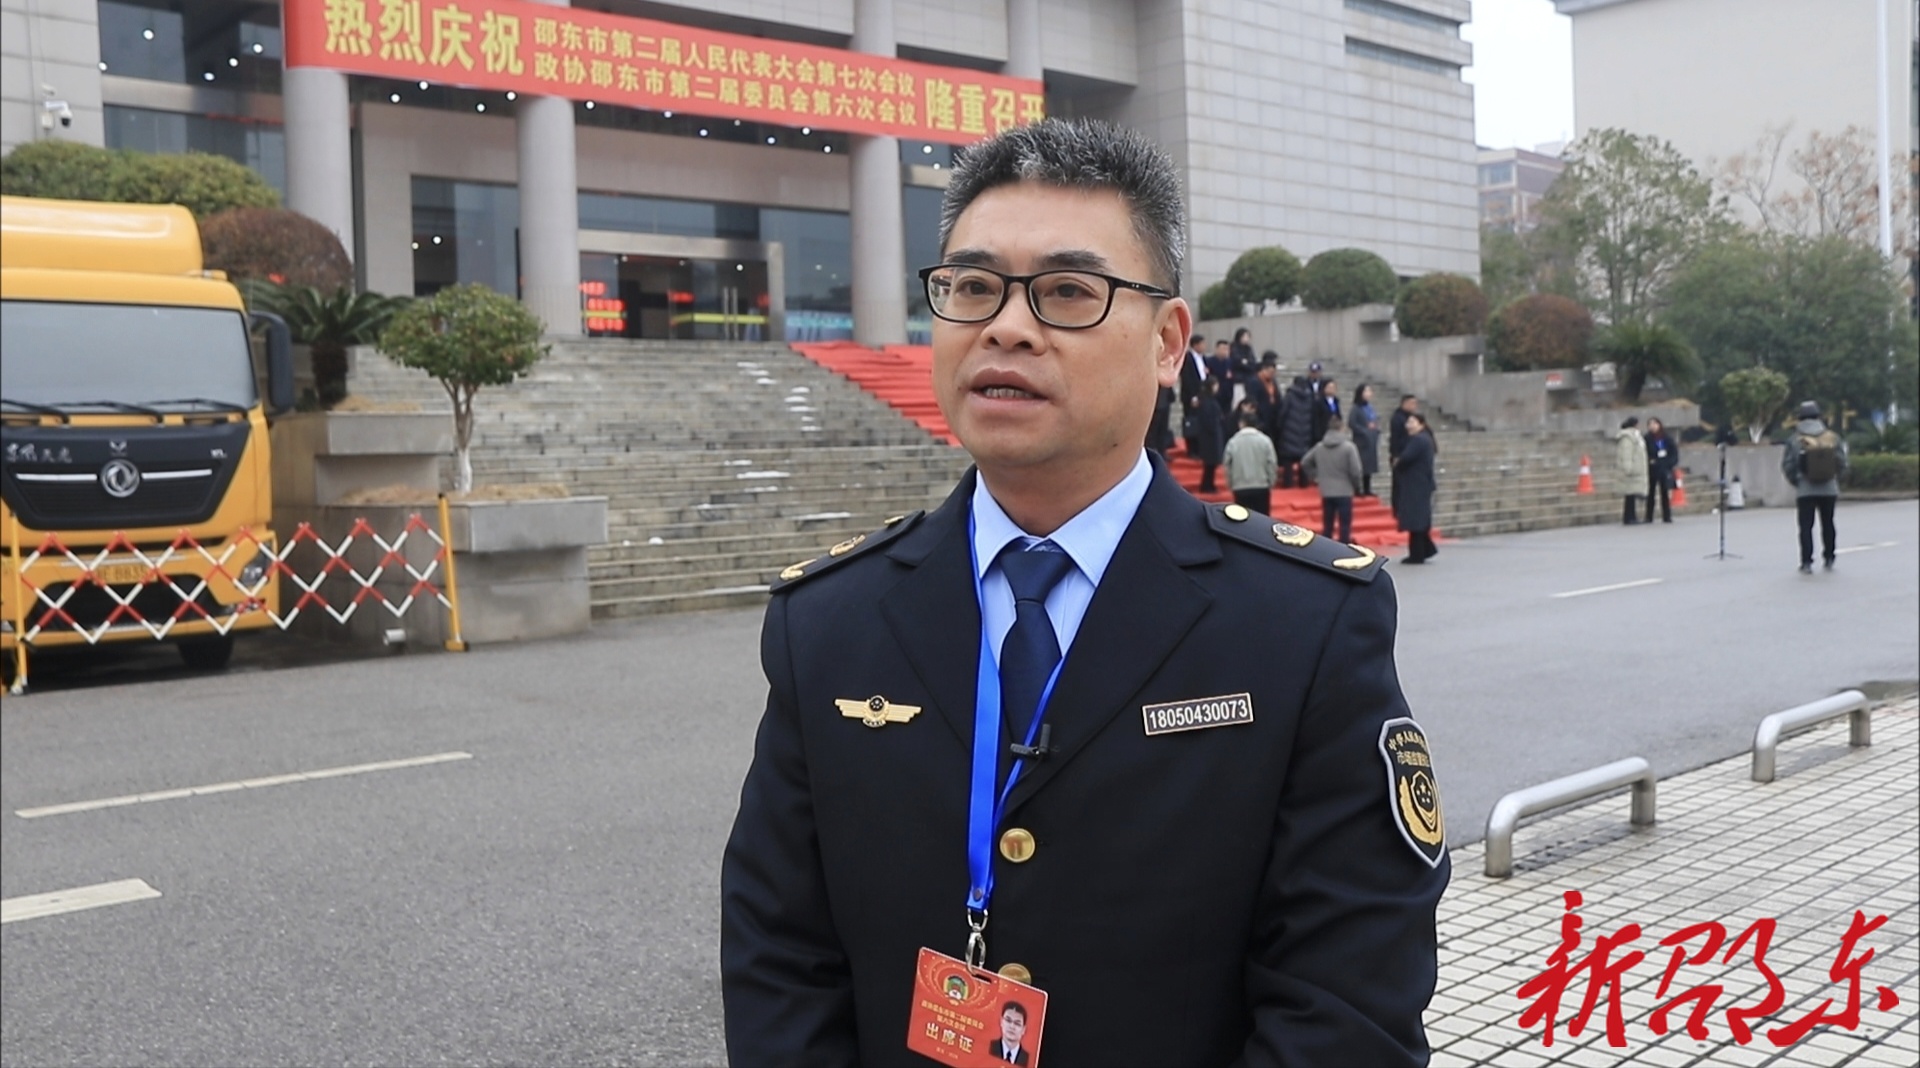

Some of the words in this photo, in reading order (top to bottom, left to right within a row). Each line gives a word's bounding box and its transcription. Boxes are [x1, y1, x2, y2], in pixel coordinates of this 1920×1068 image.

[324, 0, 524, 75] 热烈庆祝
[534, 17, 915, 97] 邵东市第二届人民代表大会第七次会议
[534, 52, 917, 125] 政协邵东市第二届委员会第六次会议
[925, 78, 1045, 134] 隆重召开
[1149, 699, 1248, 729] 18050430073
[926, 1022, 973, 1053] 出席证
